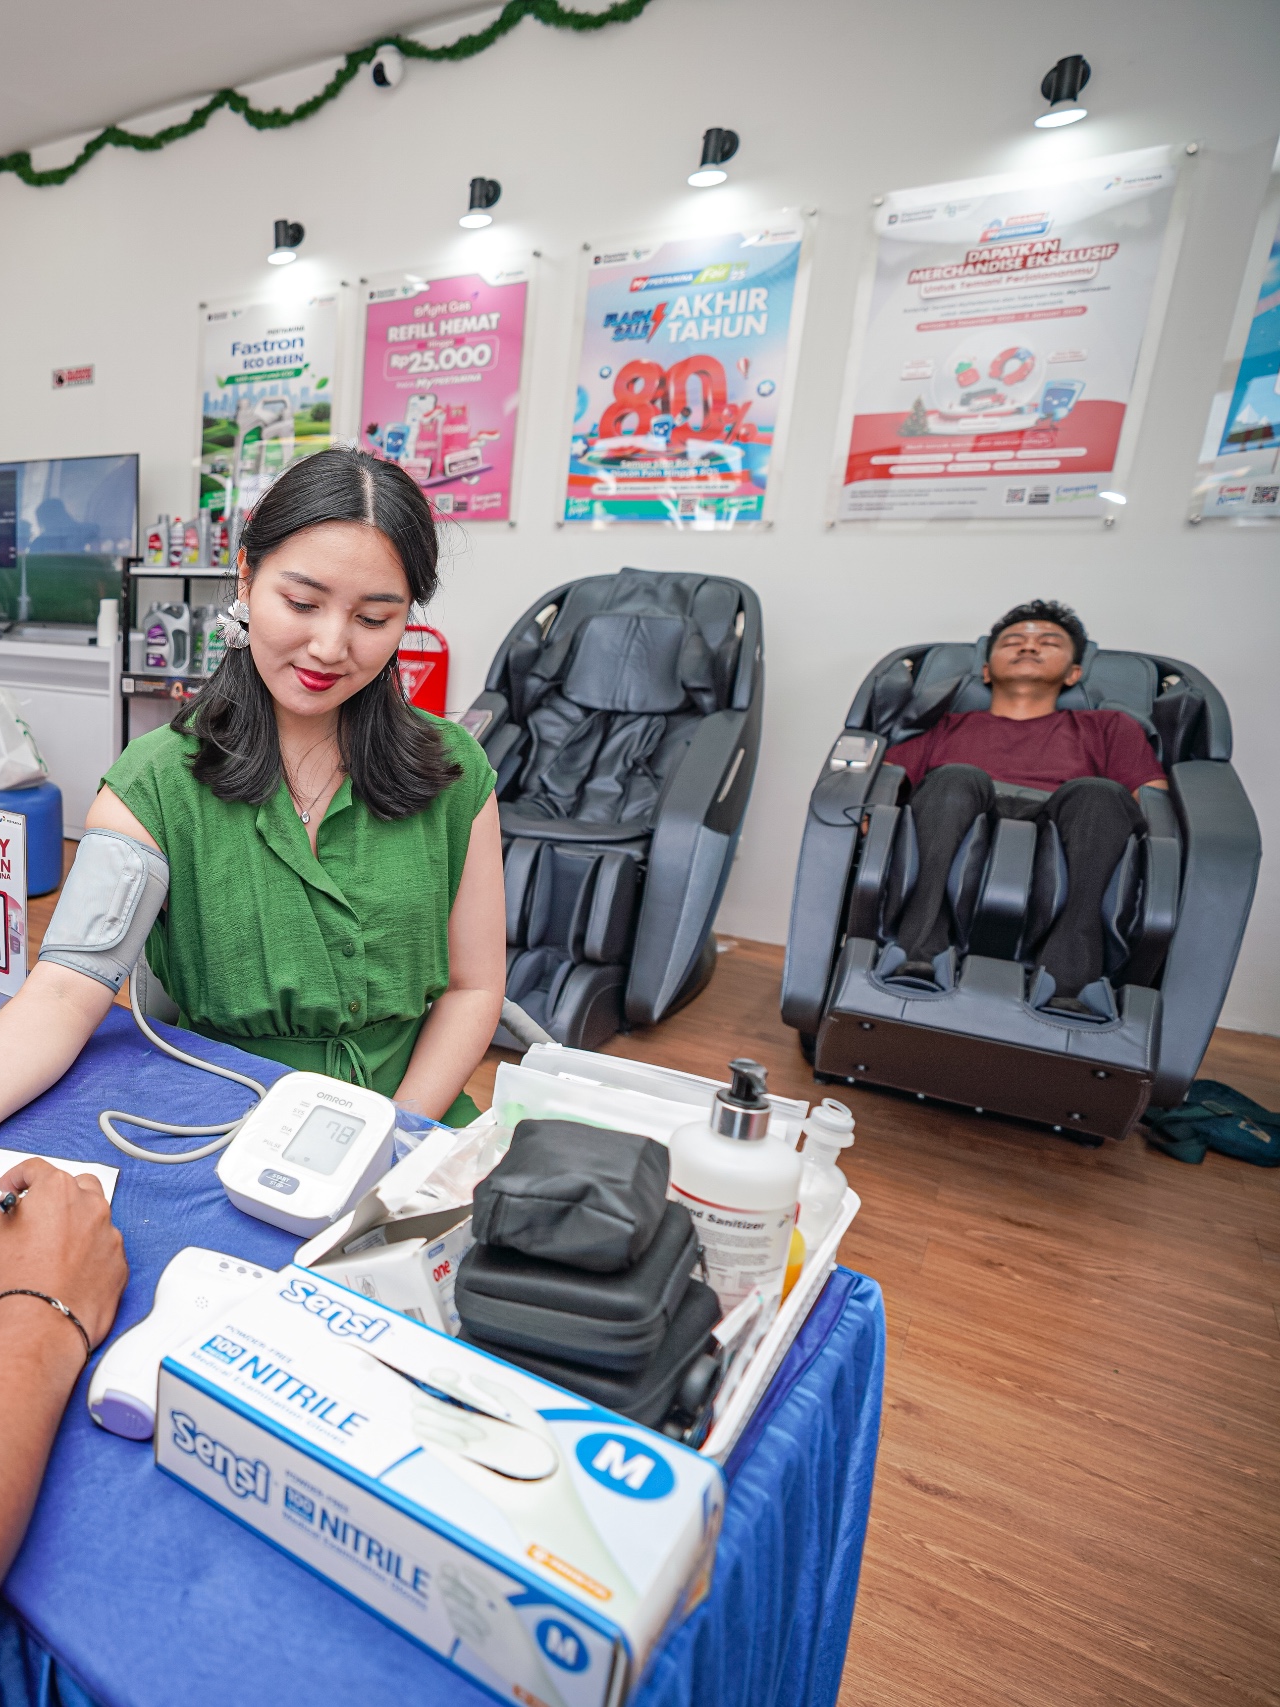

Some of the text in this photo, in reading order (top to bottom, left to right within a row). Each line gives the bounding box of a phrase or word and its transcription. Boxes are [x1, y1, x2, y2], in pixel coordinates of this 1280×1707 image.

[909, 245, 1118, 283] MERCHANDISE EKSKLUSIF
[967, 240, 1059, 263] DAPATKAN
[448, 299, 472, 313] Gas
[669, 288, 769, 320] AKHIR
[386, 312, 501, 343] REFILL HEMAT
[667, 313, 768, 343] TAHUN
[231, 337, 305, 357] Fastron
[389, 343, 492, 375] Rp25.000
[243, 354, 304, 369] ECO GREEN
[599, 354, 758, 447] 80%
[292, 1107, 306, 1116] SYS
[316, 1091, 353, 1109] OMRON
[281, 1125, 293, 1134] DIA
[326, 1120, 357, 1145] 78
[262, 1139, 282, 1149] PULSE
[269, 1180, 284, 1189] STOP
[272, 1173, 291, 1184] START
[707, 1213, 766, 1231] Sanitizer
[279, 1279, 391, 1343] Sensi
[210, 1335, 244, 1359] 100
[238, 1354, 371, 1438] NITRILE
[170, 1410, 272, 1506] Sensi
[591, 1438, 656, 1491] M
[319, 1507, 432, 1601] NITRILE
[544, 1624, 579, 1667] M
